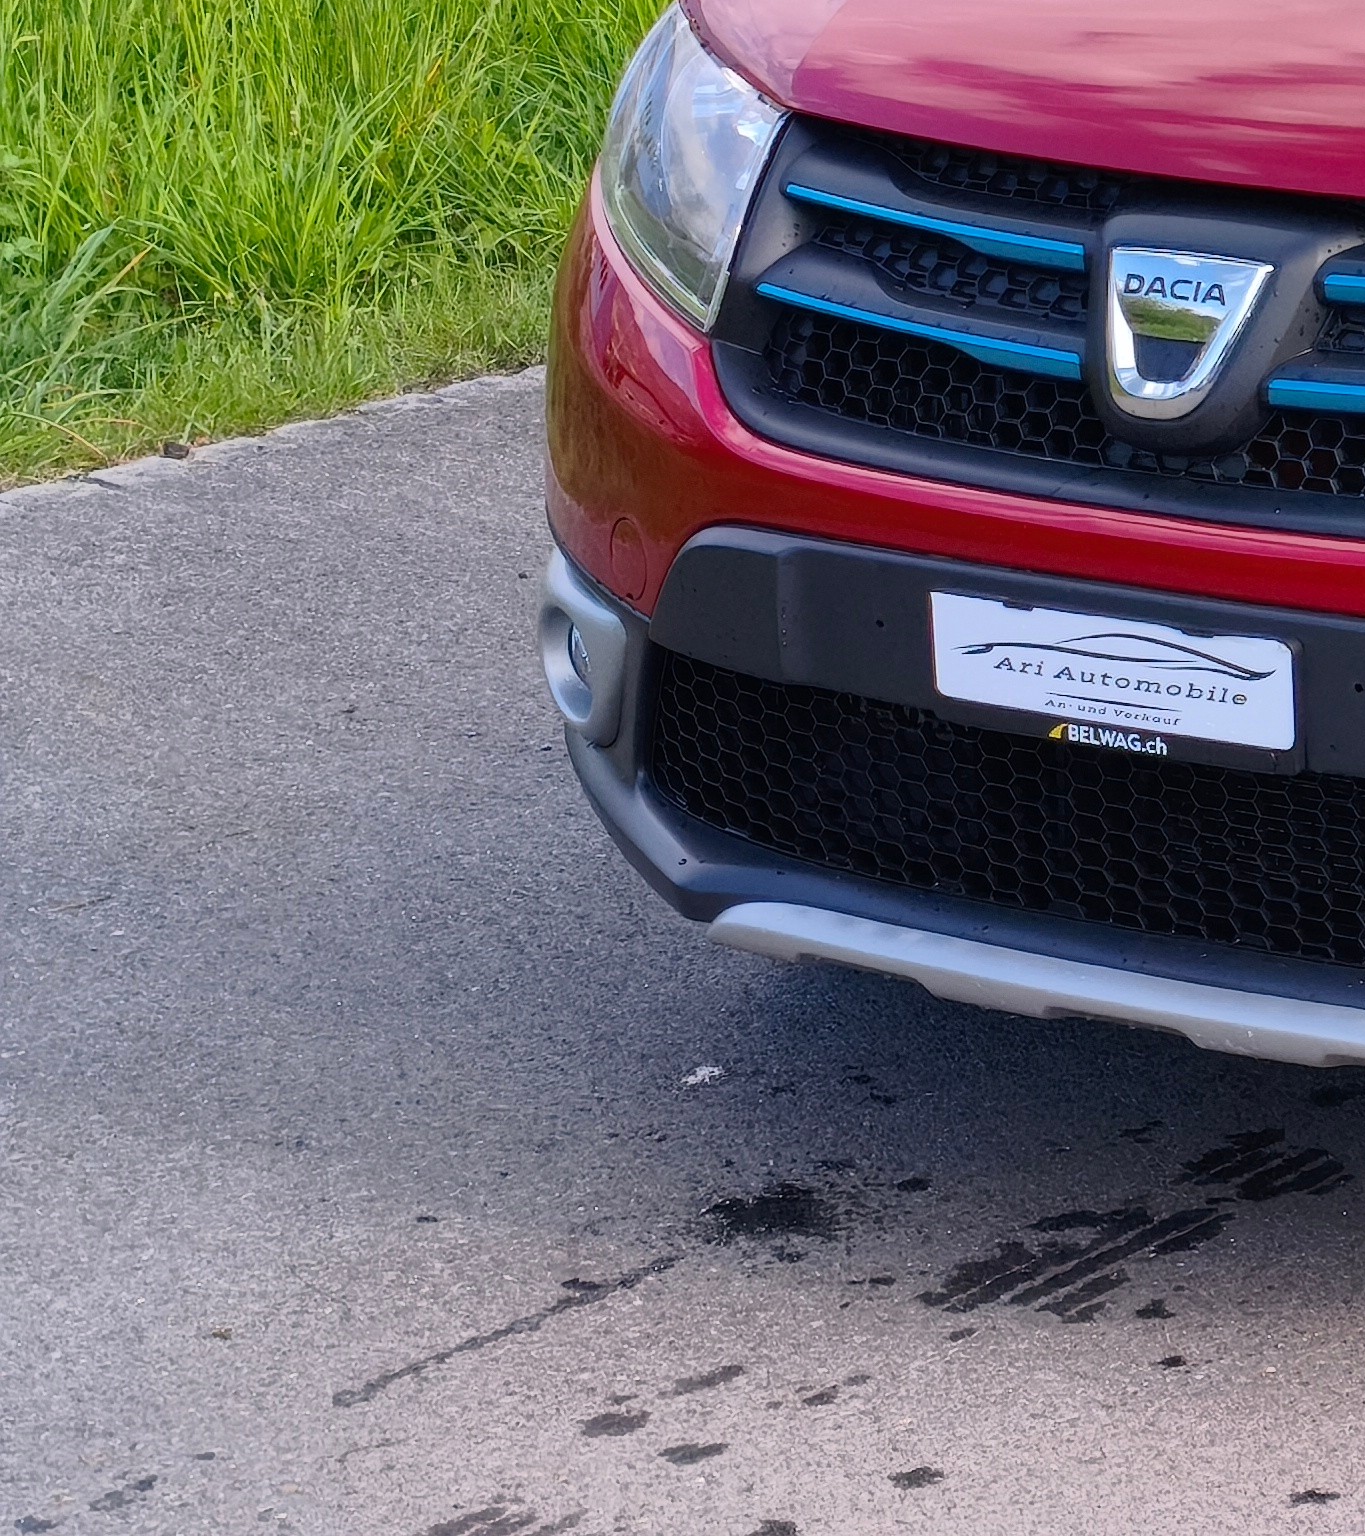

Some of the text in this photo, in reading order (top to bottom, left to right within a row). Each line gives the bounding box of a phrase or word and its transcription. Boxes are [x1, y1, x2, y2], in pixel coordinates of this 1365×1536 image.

[1123, 272, 1226, 306] DACIA
[993, 656, 1248, 705] Ari Automobile
[1077, 704, 1106, 715] und
[1067, 723, 1168, 756] BELWAG.ch
